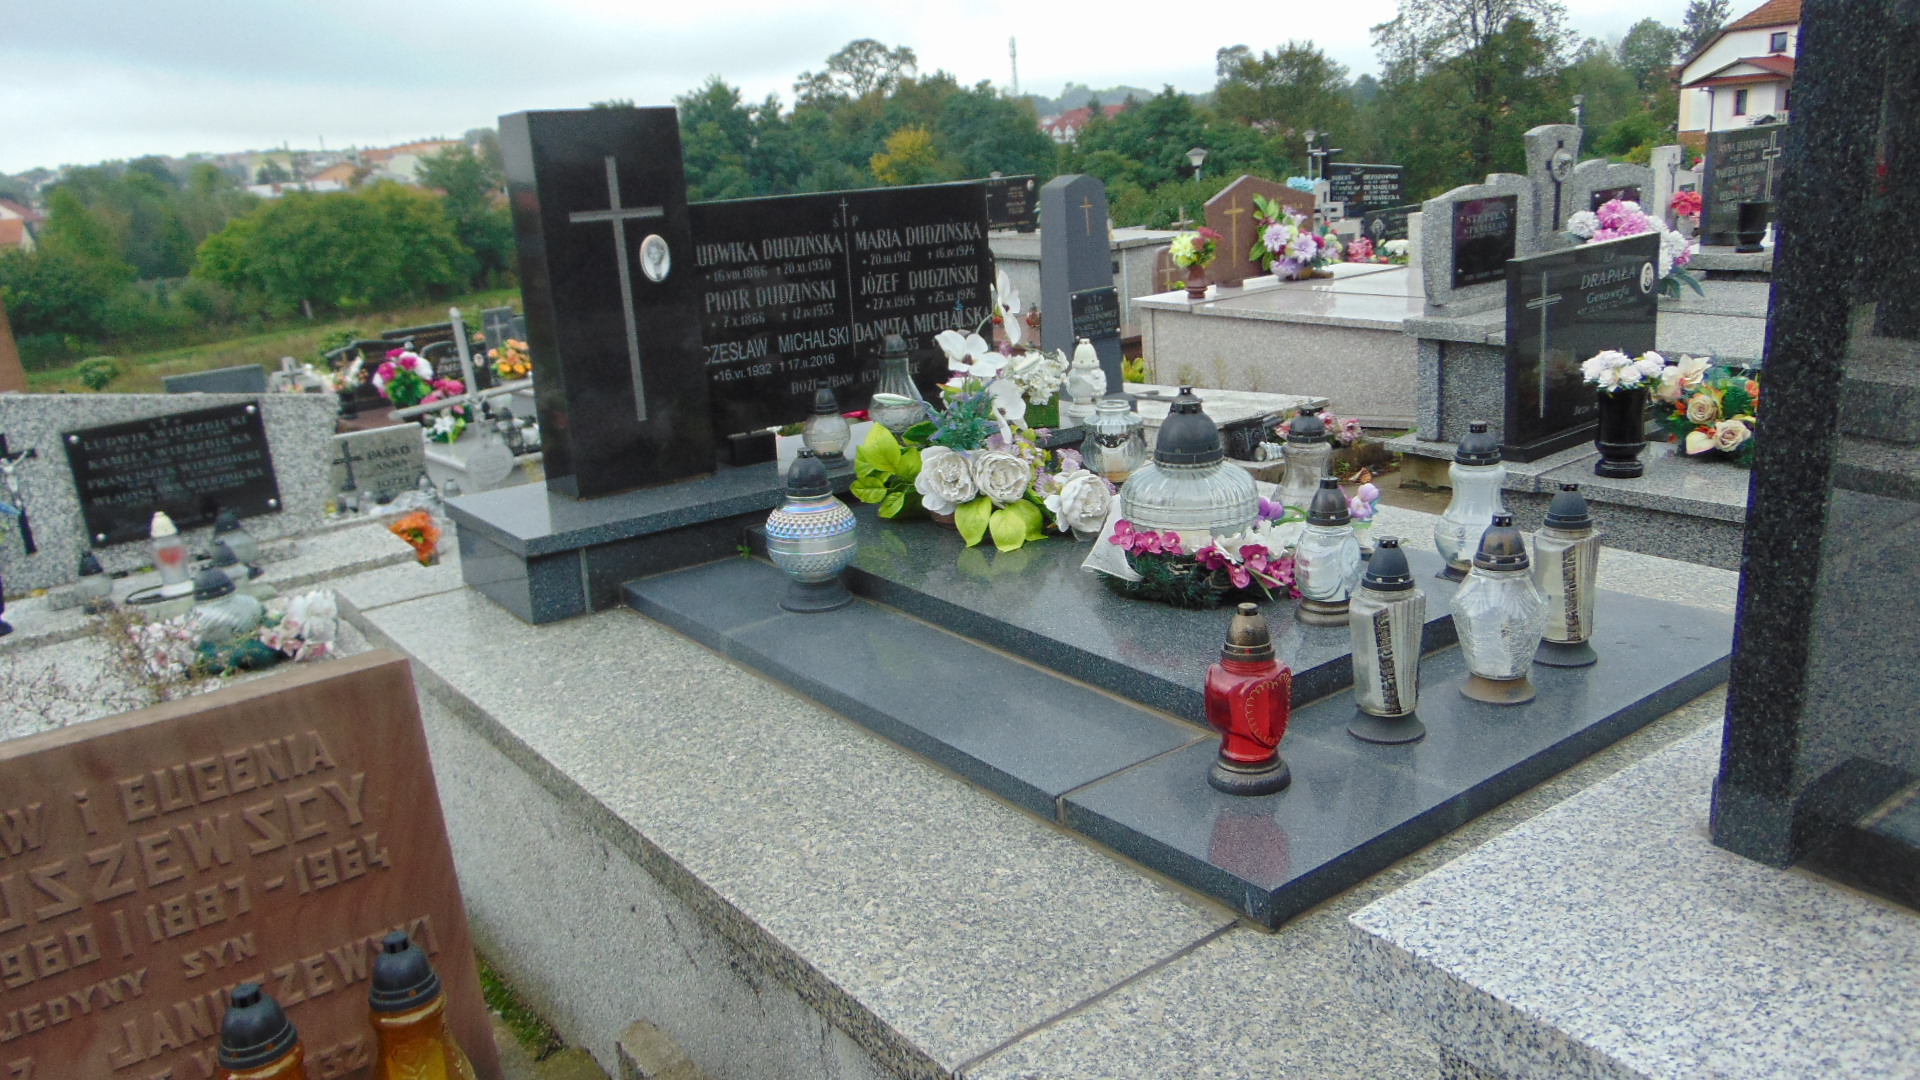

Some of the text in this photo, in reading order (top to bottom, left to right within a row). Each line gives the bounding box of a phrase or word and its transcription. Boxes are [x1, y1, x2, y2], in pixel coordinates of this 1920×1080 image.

[693, 231, 844, 267] UDWIKA DUDZIŃSKA
[855, 219, 982, 251] MARIA DUDZIŃSKA
[705, 278, 837, 313] PIOTR DUDZIŃSKI
[860, 264, 979, 296] JÓZEF DUDZIŃSKI
[854, 305, 993, 343] DANUTA MICHALSKA
[702, 337, 768, 366] CZESŁAW
[778, 325, 850, 354] MICHALSKI
[118, 729, 337, 826] EUGENIA
[146, 875, 253, 943] 1887
[0, 931, 258, 1043] JEDYNY SYN
